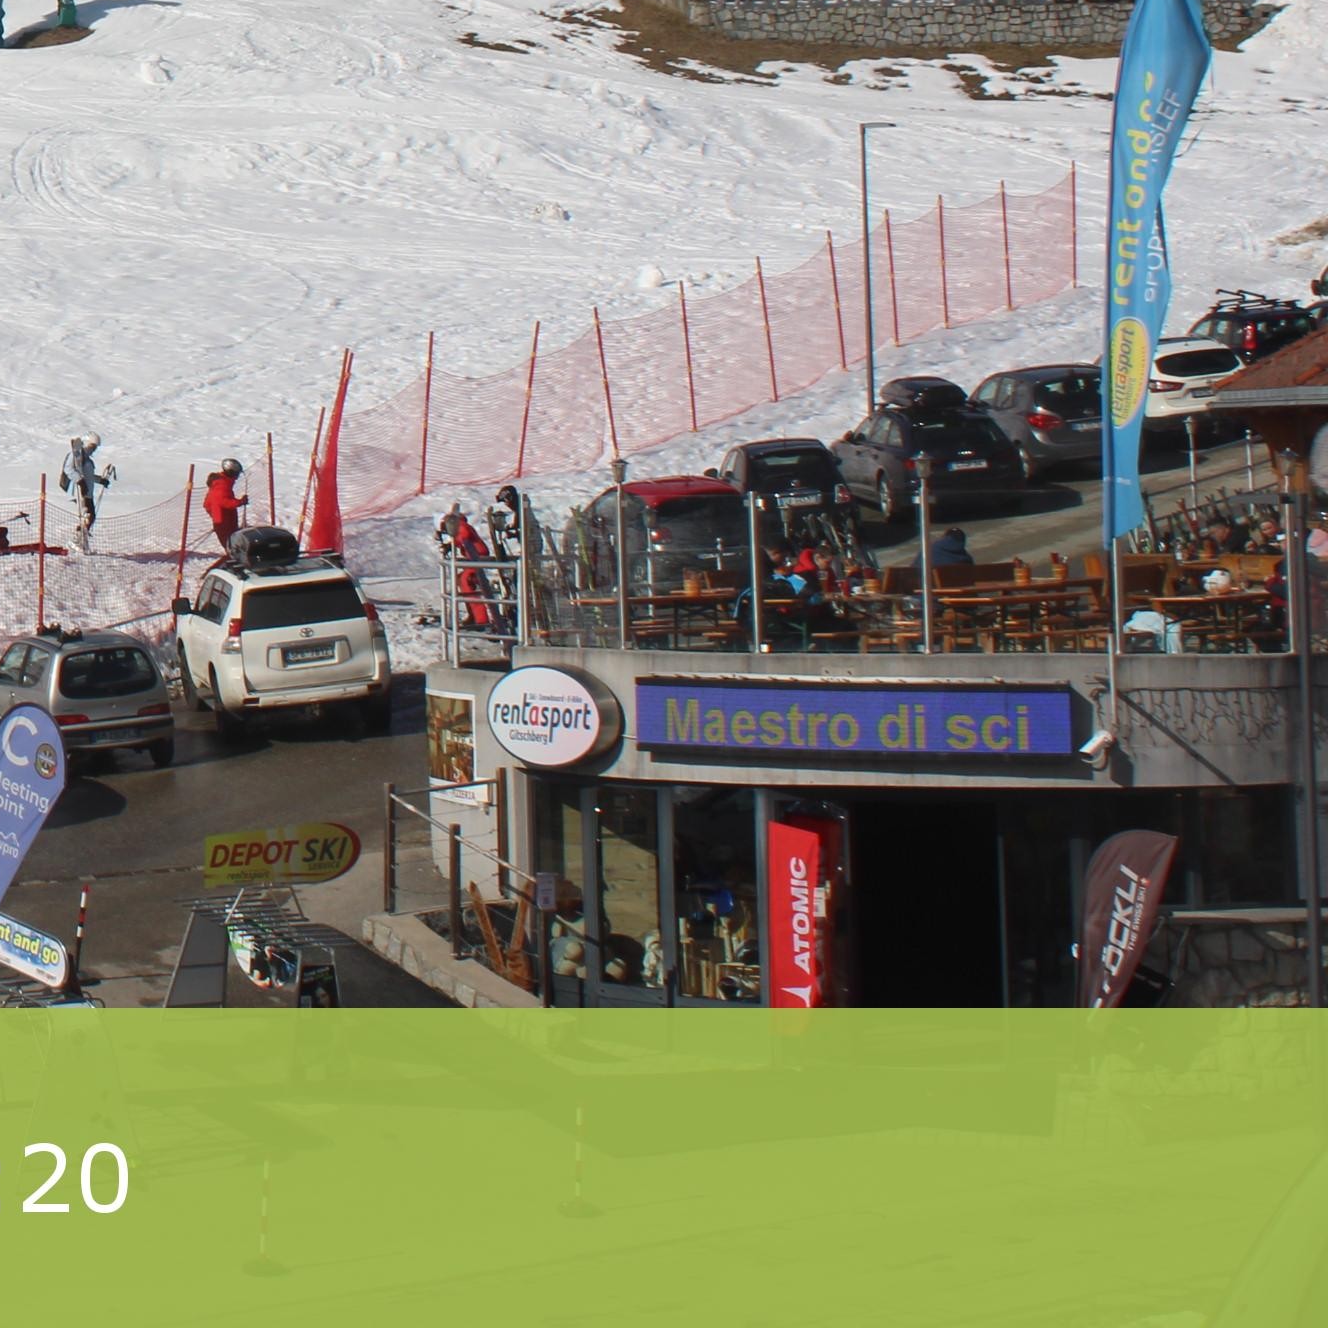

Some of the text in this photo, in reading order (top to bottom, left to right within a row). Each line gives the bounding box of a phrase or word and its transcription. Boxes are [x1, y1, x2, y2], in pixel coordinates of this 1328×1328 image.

[2, 715, 38, 766] C
[493, 692, 592, 743] rentasport
[509, 729, 548, 745] Gitschberg
[666, 697, 1030, 751] Maestro di sci
[209, 836, 348, 869] DEPOT SKI
[790, 857, 811, 976] ATOMIC
[13, 932, 40, 955] and
[41, 946, 60, 964] go
